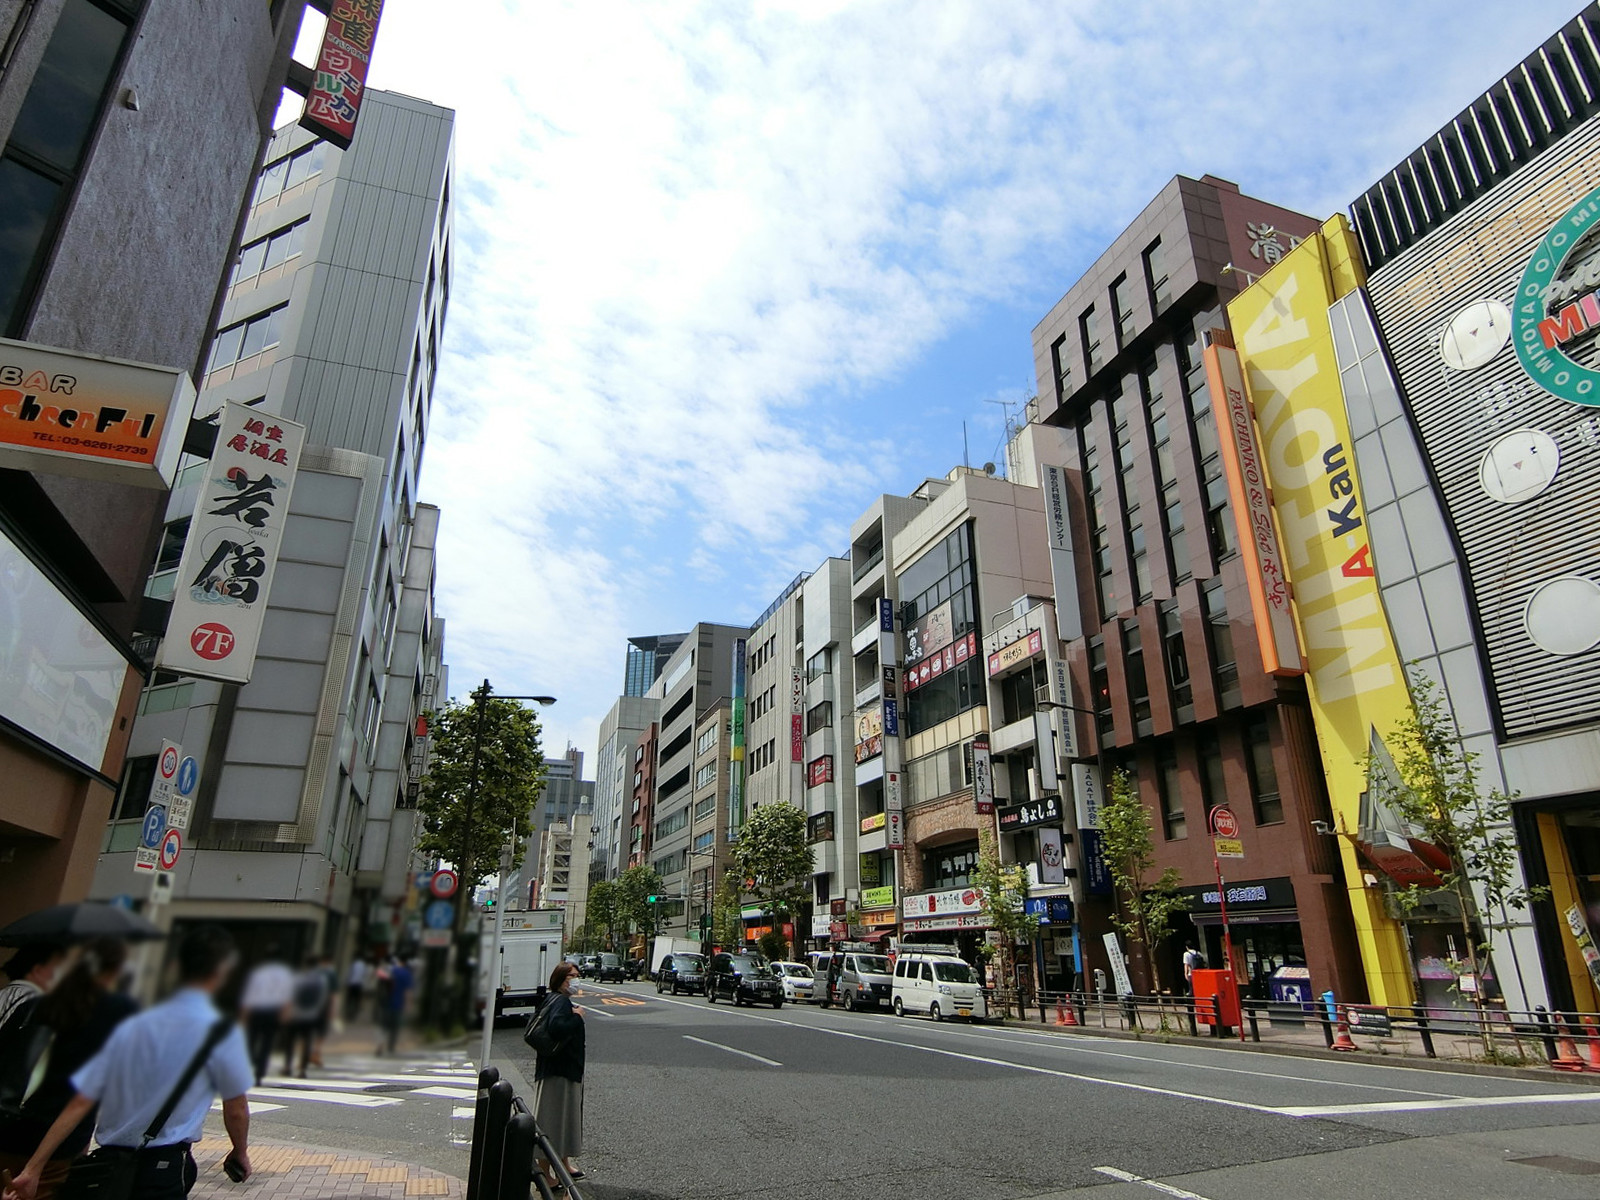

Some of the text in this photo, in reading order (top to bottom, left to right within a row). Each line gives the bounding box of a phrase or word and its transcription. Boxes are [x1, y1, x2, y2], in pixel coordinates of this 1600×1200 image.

[1246, 221, 1303, 265] 清
[0, 366, 77, 395] BAR
[226, 433, 289, 467] 居酒屋
[1228, 387, 1260, 485] PACHINKO
[1243, 272, 1396, 705] MITOYA
[193, 627, 233, 654] 7F
[164, 756, 175, 770] 30
[145, 814, 158, 841] P
